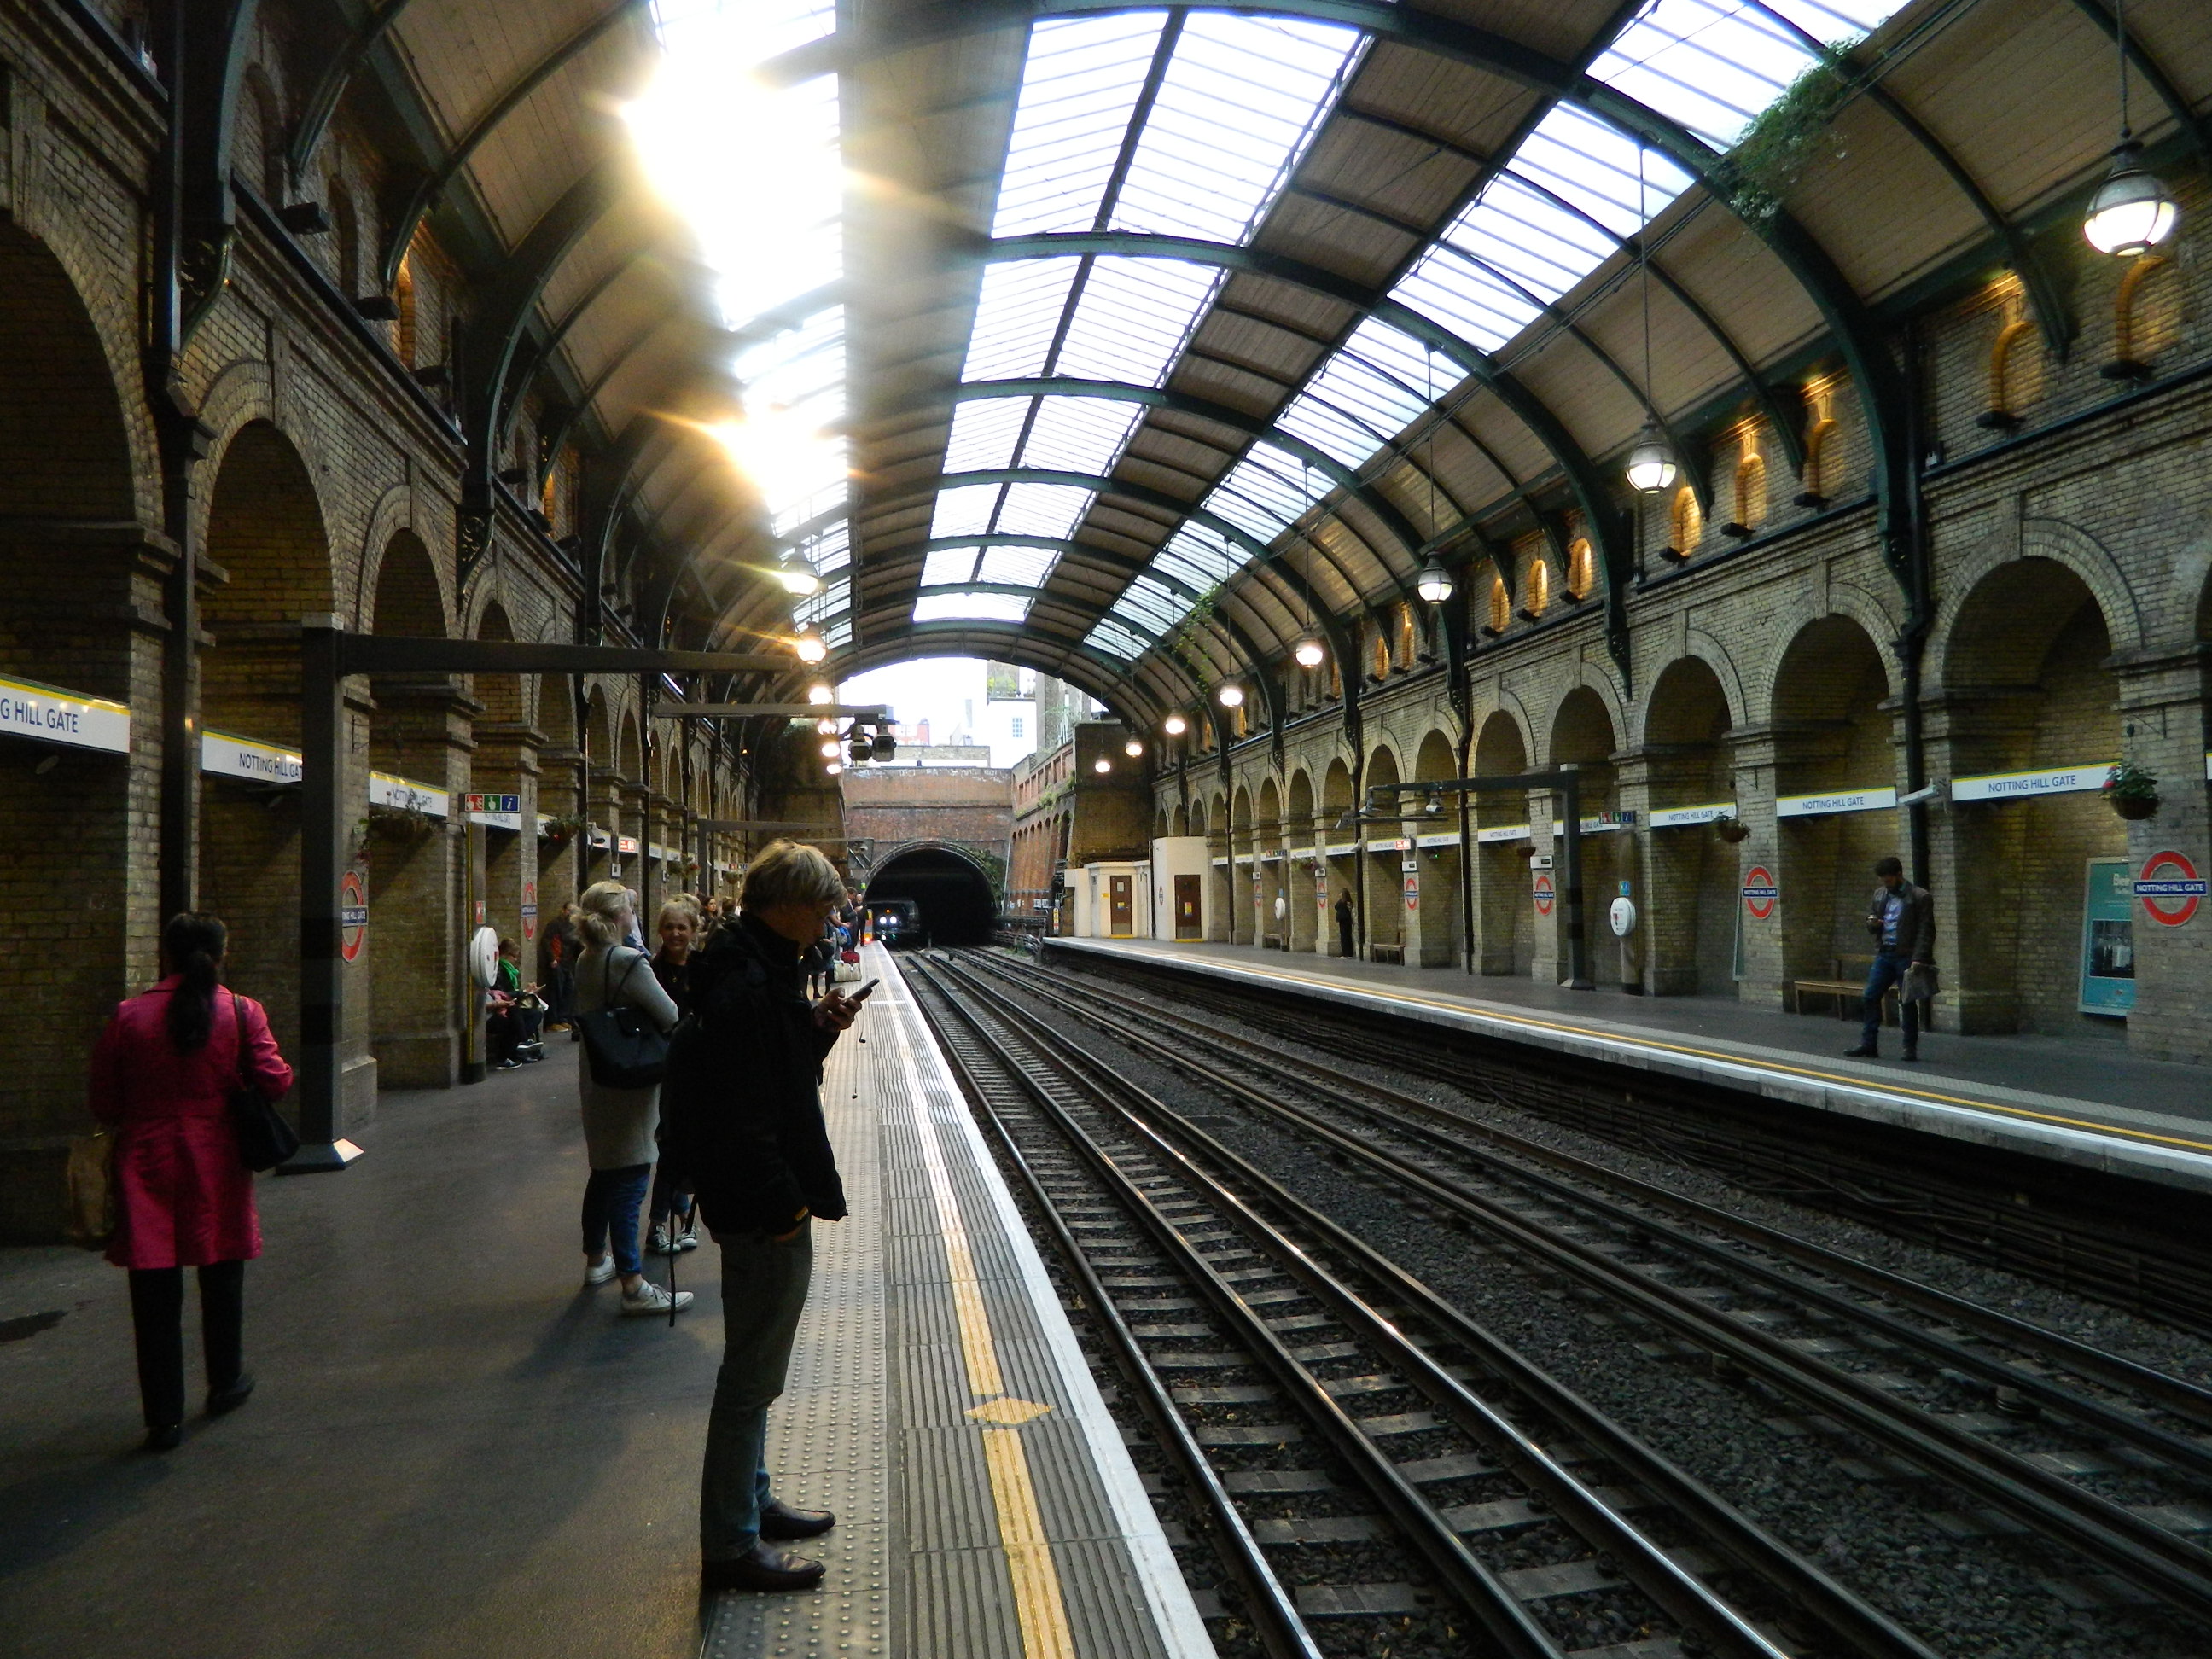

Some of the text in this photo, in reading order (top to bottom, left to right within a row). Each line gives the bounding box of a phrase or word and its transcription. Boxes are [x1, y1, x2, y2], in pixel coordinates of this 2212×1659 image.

[15, 701, 43, 726] HILL
[47, 708, 79, 733] GATE
[239, 753, 273, 773] NOTTING
[290, 763, 303, 778] GAT
[1988, 774, 2076, 793] NOTTING HILL GATE
[1802, 796, 1864, 810] NOTTING HILL GATE
[1668, 812, 1689, 821] NOTTING
[1701, 810, 1713, 818] GATE
[2136, 884, 2168, 893] NOTTING
[2168, 883, 2183, 892] HILL
[2185, 883, 2204, 892] GATE
